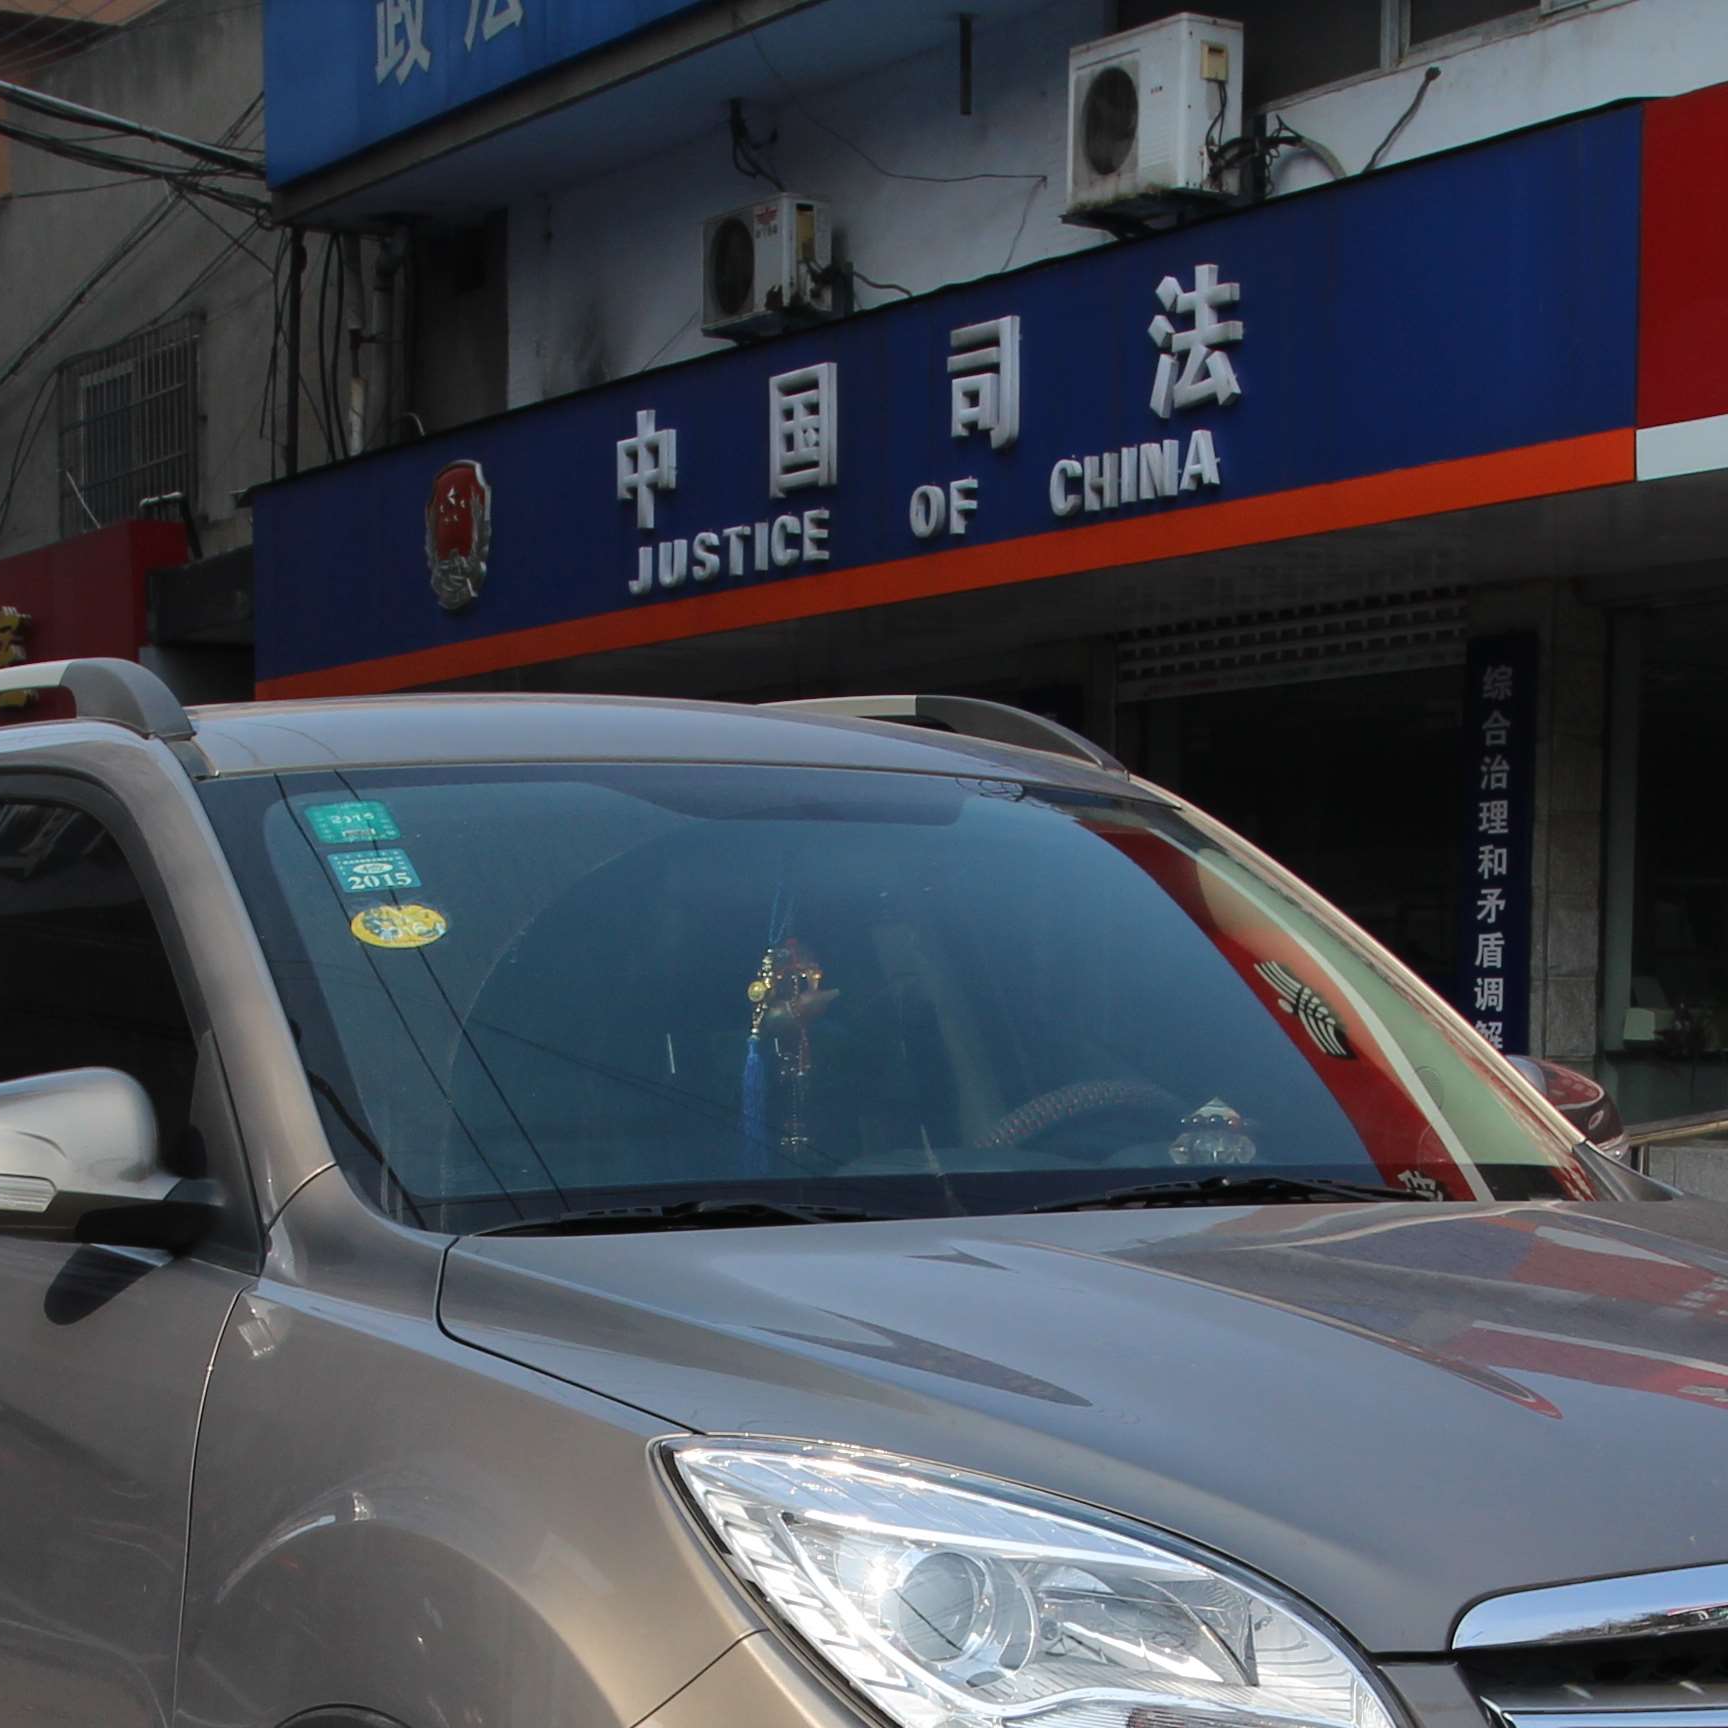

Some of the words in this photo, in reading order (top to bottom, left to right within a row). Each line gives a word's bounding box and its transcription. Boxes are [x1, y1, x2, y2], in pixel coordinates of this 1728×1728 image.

[616, 263, 1244, 530] 中国司法
[628, 509, 831, 596] JUSTICE
[910, 476, 979, 538] OF
[1049, 428, 1221, 517] CHINA
[347, 872, 413, 890] 2015
